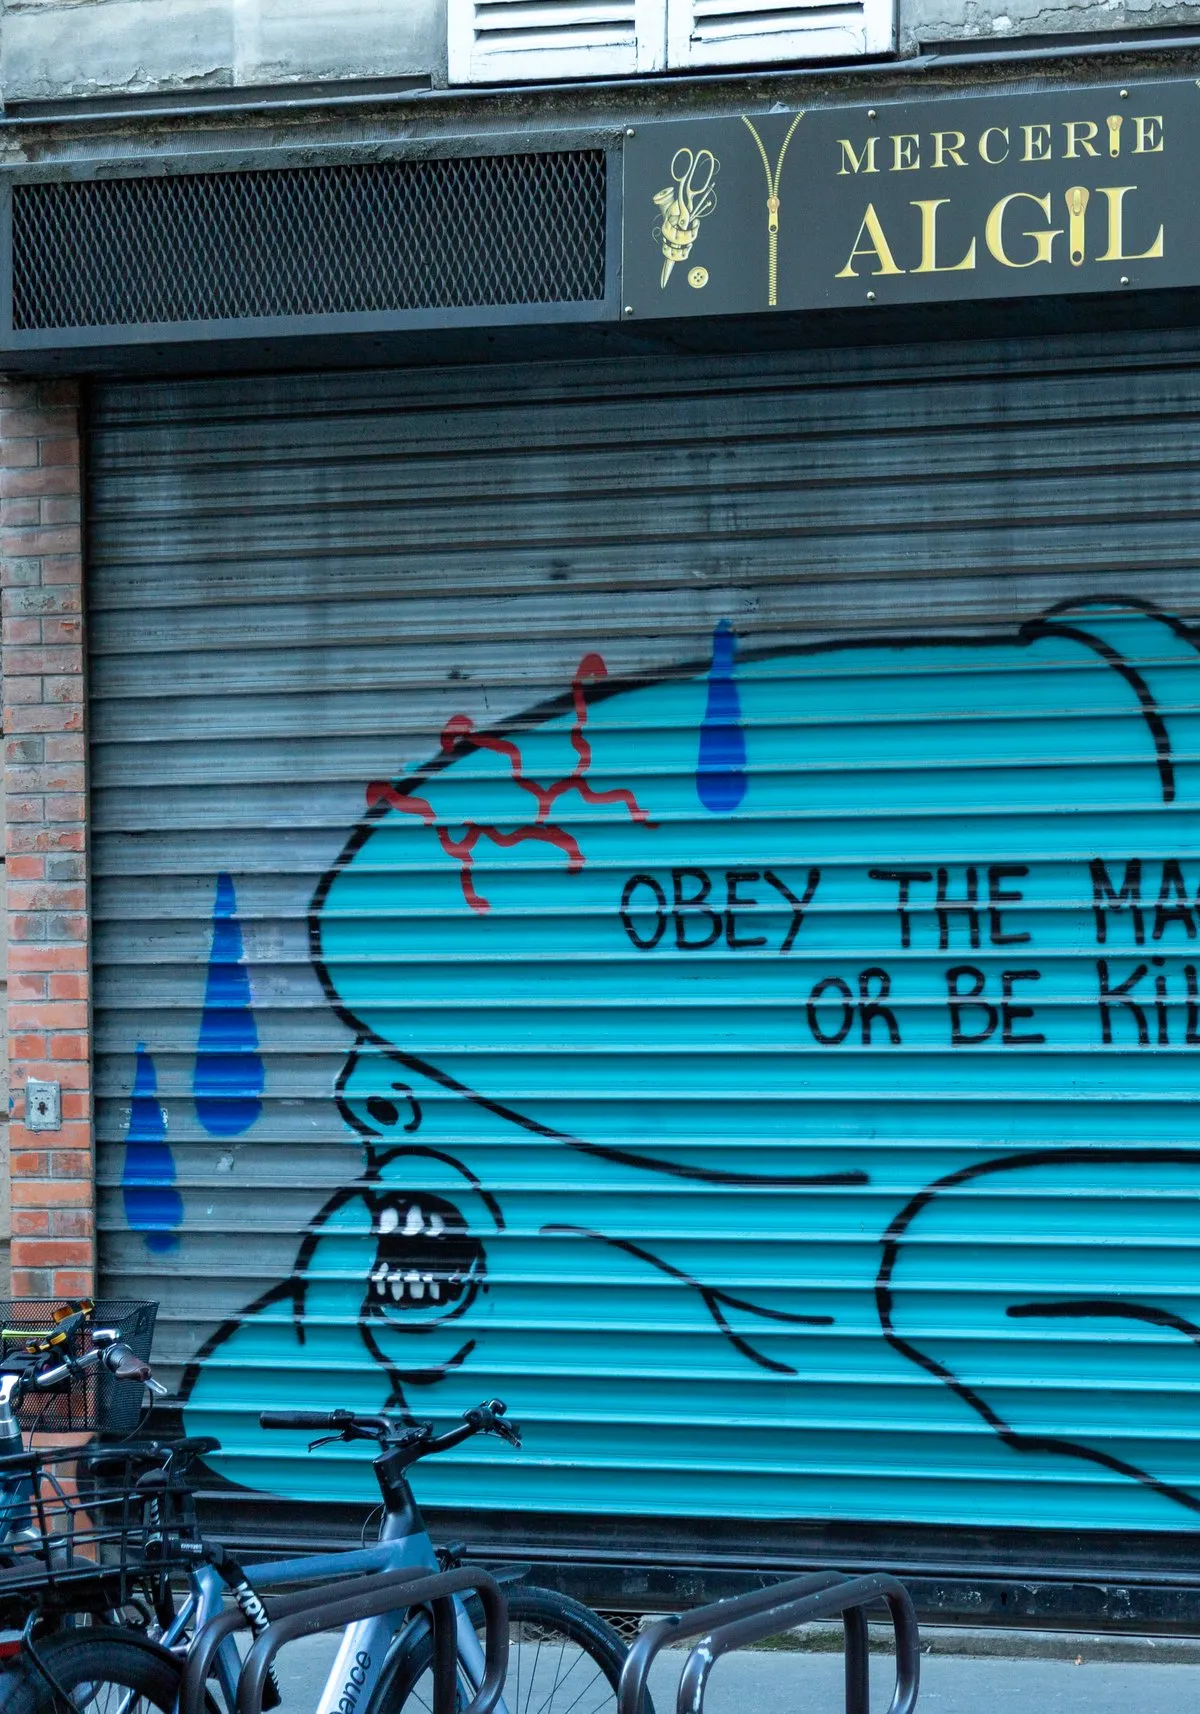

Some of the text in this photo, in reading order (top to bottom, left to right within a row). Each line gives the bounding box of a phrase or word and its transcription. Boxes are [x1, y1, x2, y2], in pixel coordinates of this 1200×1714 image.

[836, 114, 1165, 176] MERCERIE
[834, 184, 1165, 279] ALGIL
[618, 866, 821, 955] OBEY
[868, 865, 1031, 950] THE
[807, 967, 902, 1046] OR
[945, 964, 1047, 1046] BE
[234, 1581, 272, 1634] KRY
[329, 1650, 372, 1714] ance
